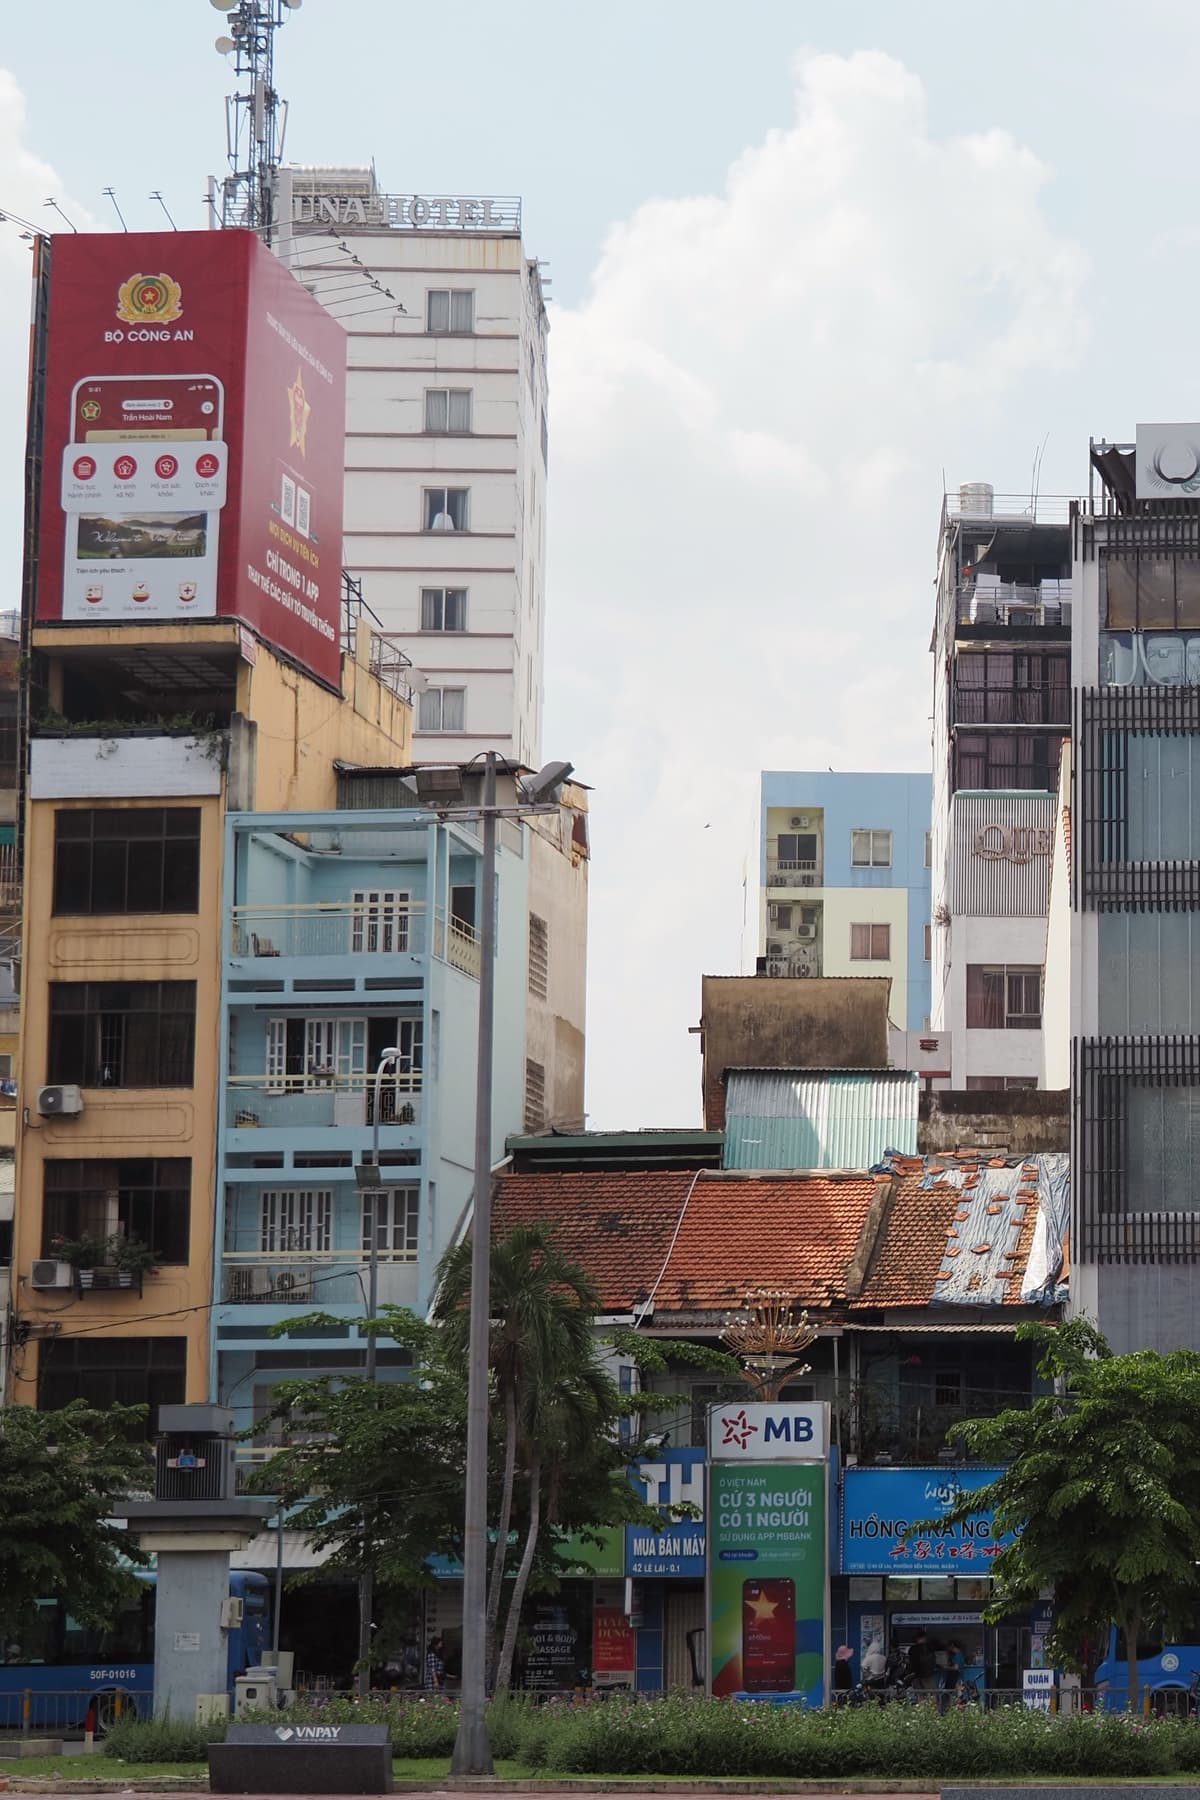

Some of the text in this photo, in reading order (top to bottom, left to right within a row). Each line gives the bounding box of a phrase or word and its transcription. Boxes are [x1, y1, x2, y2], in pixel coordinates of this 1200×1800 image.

[382, 198, 504, 226] HOTEL
[104, 328, 194, 344] BỘ CÔNG AN
[279, 557, 301, 590] TRONG
[306, 580, 320, 602] APP
[972, 823, 1056, 865] QUE
[764, 1417, 814, 1442] MB
[727, 1477, 745, 1488] VIỆT
[747, 1478, 767, 1487] NAM
[719, 1488, 812, 1508] CỨ 3 NGƯỜI
[719, 1508, 809, 1528] CÓ 1 NGƯỜI
[849, 1512, 908, 1539] HỒNG
[633, 1533, 706, 1556] MUA BÁN MÁY
[758, 1532, 775, 1541] APP
[776, 1532, 812, 1541] MBBANK
[632, 1563, 643, 1573] 42
[534, 1645, 572, 1655] ASSAGE
[90, 1669, 136, 1679] 50F-01016
[295, 1726, 342, 1738] VNPAY
